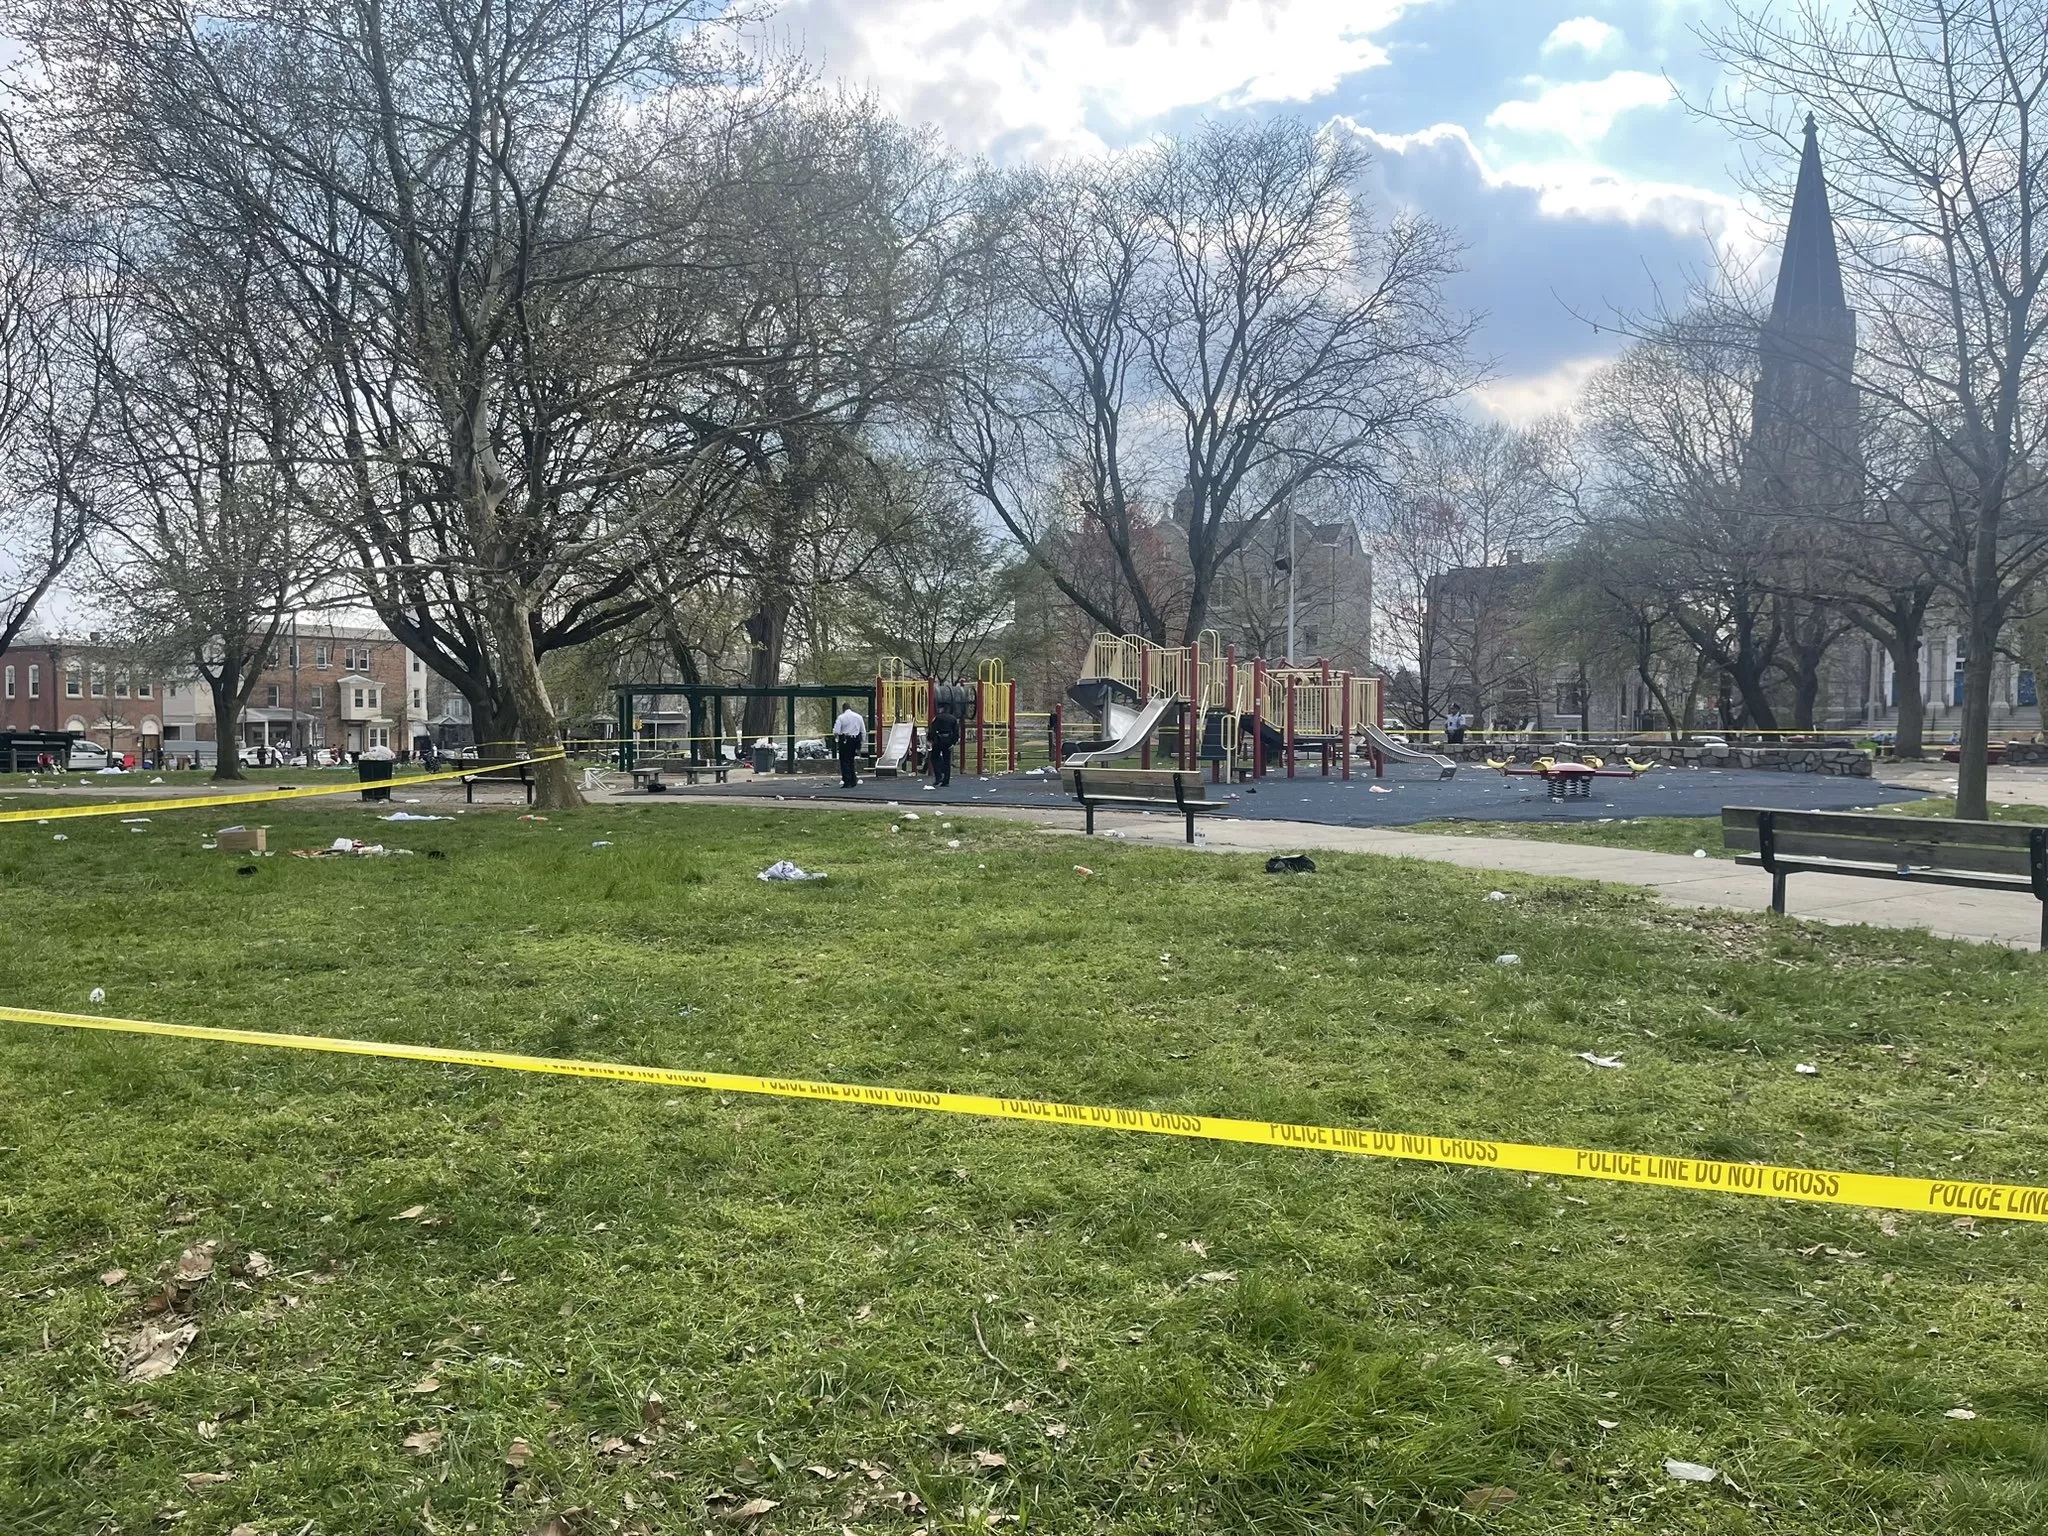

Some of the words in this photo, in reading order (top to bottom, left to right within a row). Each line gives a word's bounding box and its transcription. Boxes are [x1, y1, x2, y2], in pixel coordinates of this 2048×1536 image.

[1269, 1124, 1327, 1145] POLICE
[1331, 1129, 1368, 1149] LINE
[1372, 1133, 1396, 1152] DO
[1401, 1135, 1433, 1156] NOT
[1440, 1139, 1498, 1162] CROSS
[1577, 1151, 1641, 1176] POLICE
[1647, 1157, 1689, 1182] LINE
[1695, 1162, 1722, 1185] DO
[1727, 1165, 1768, 1189] NOT
[1772, 1169, 1841, 1197] CROSS
[1928, 1183, 2006, 1211] POLICE
